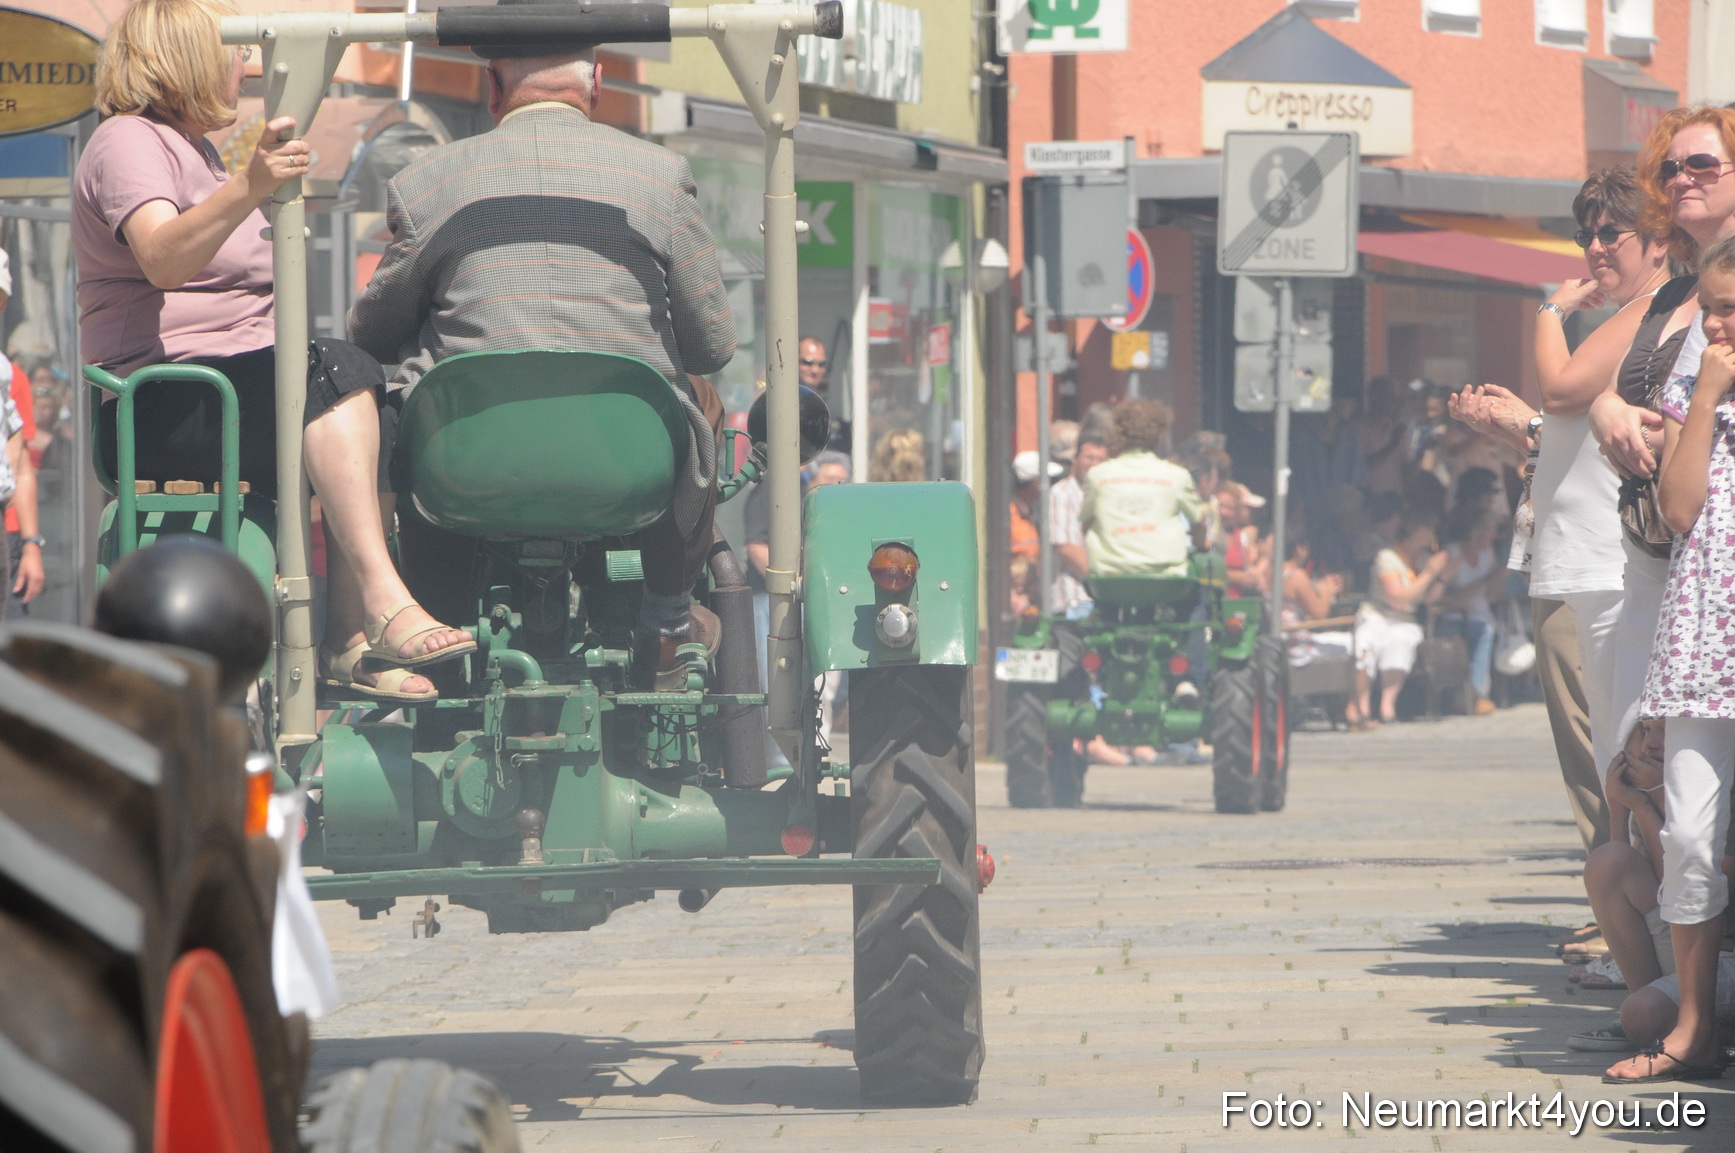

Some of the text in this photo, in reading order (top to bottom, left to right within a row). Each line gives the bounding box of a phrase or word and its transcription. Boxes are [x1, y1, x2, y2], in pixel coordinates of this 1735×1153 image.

[1245, 86, 1374, 128] Creppresso
[1029, 146, 1111, 165] Klostergasse
[1251, 237, 1317, 260] ZONE
